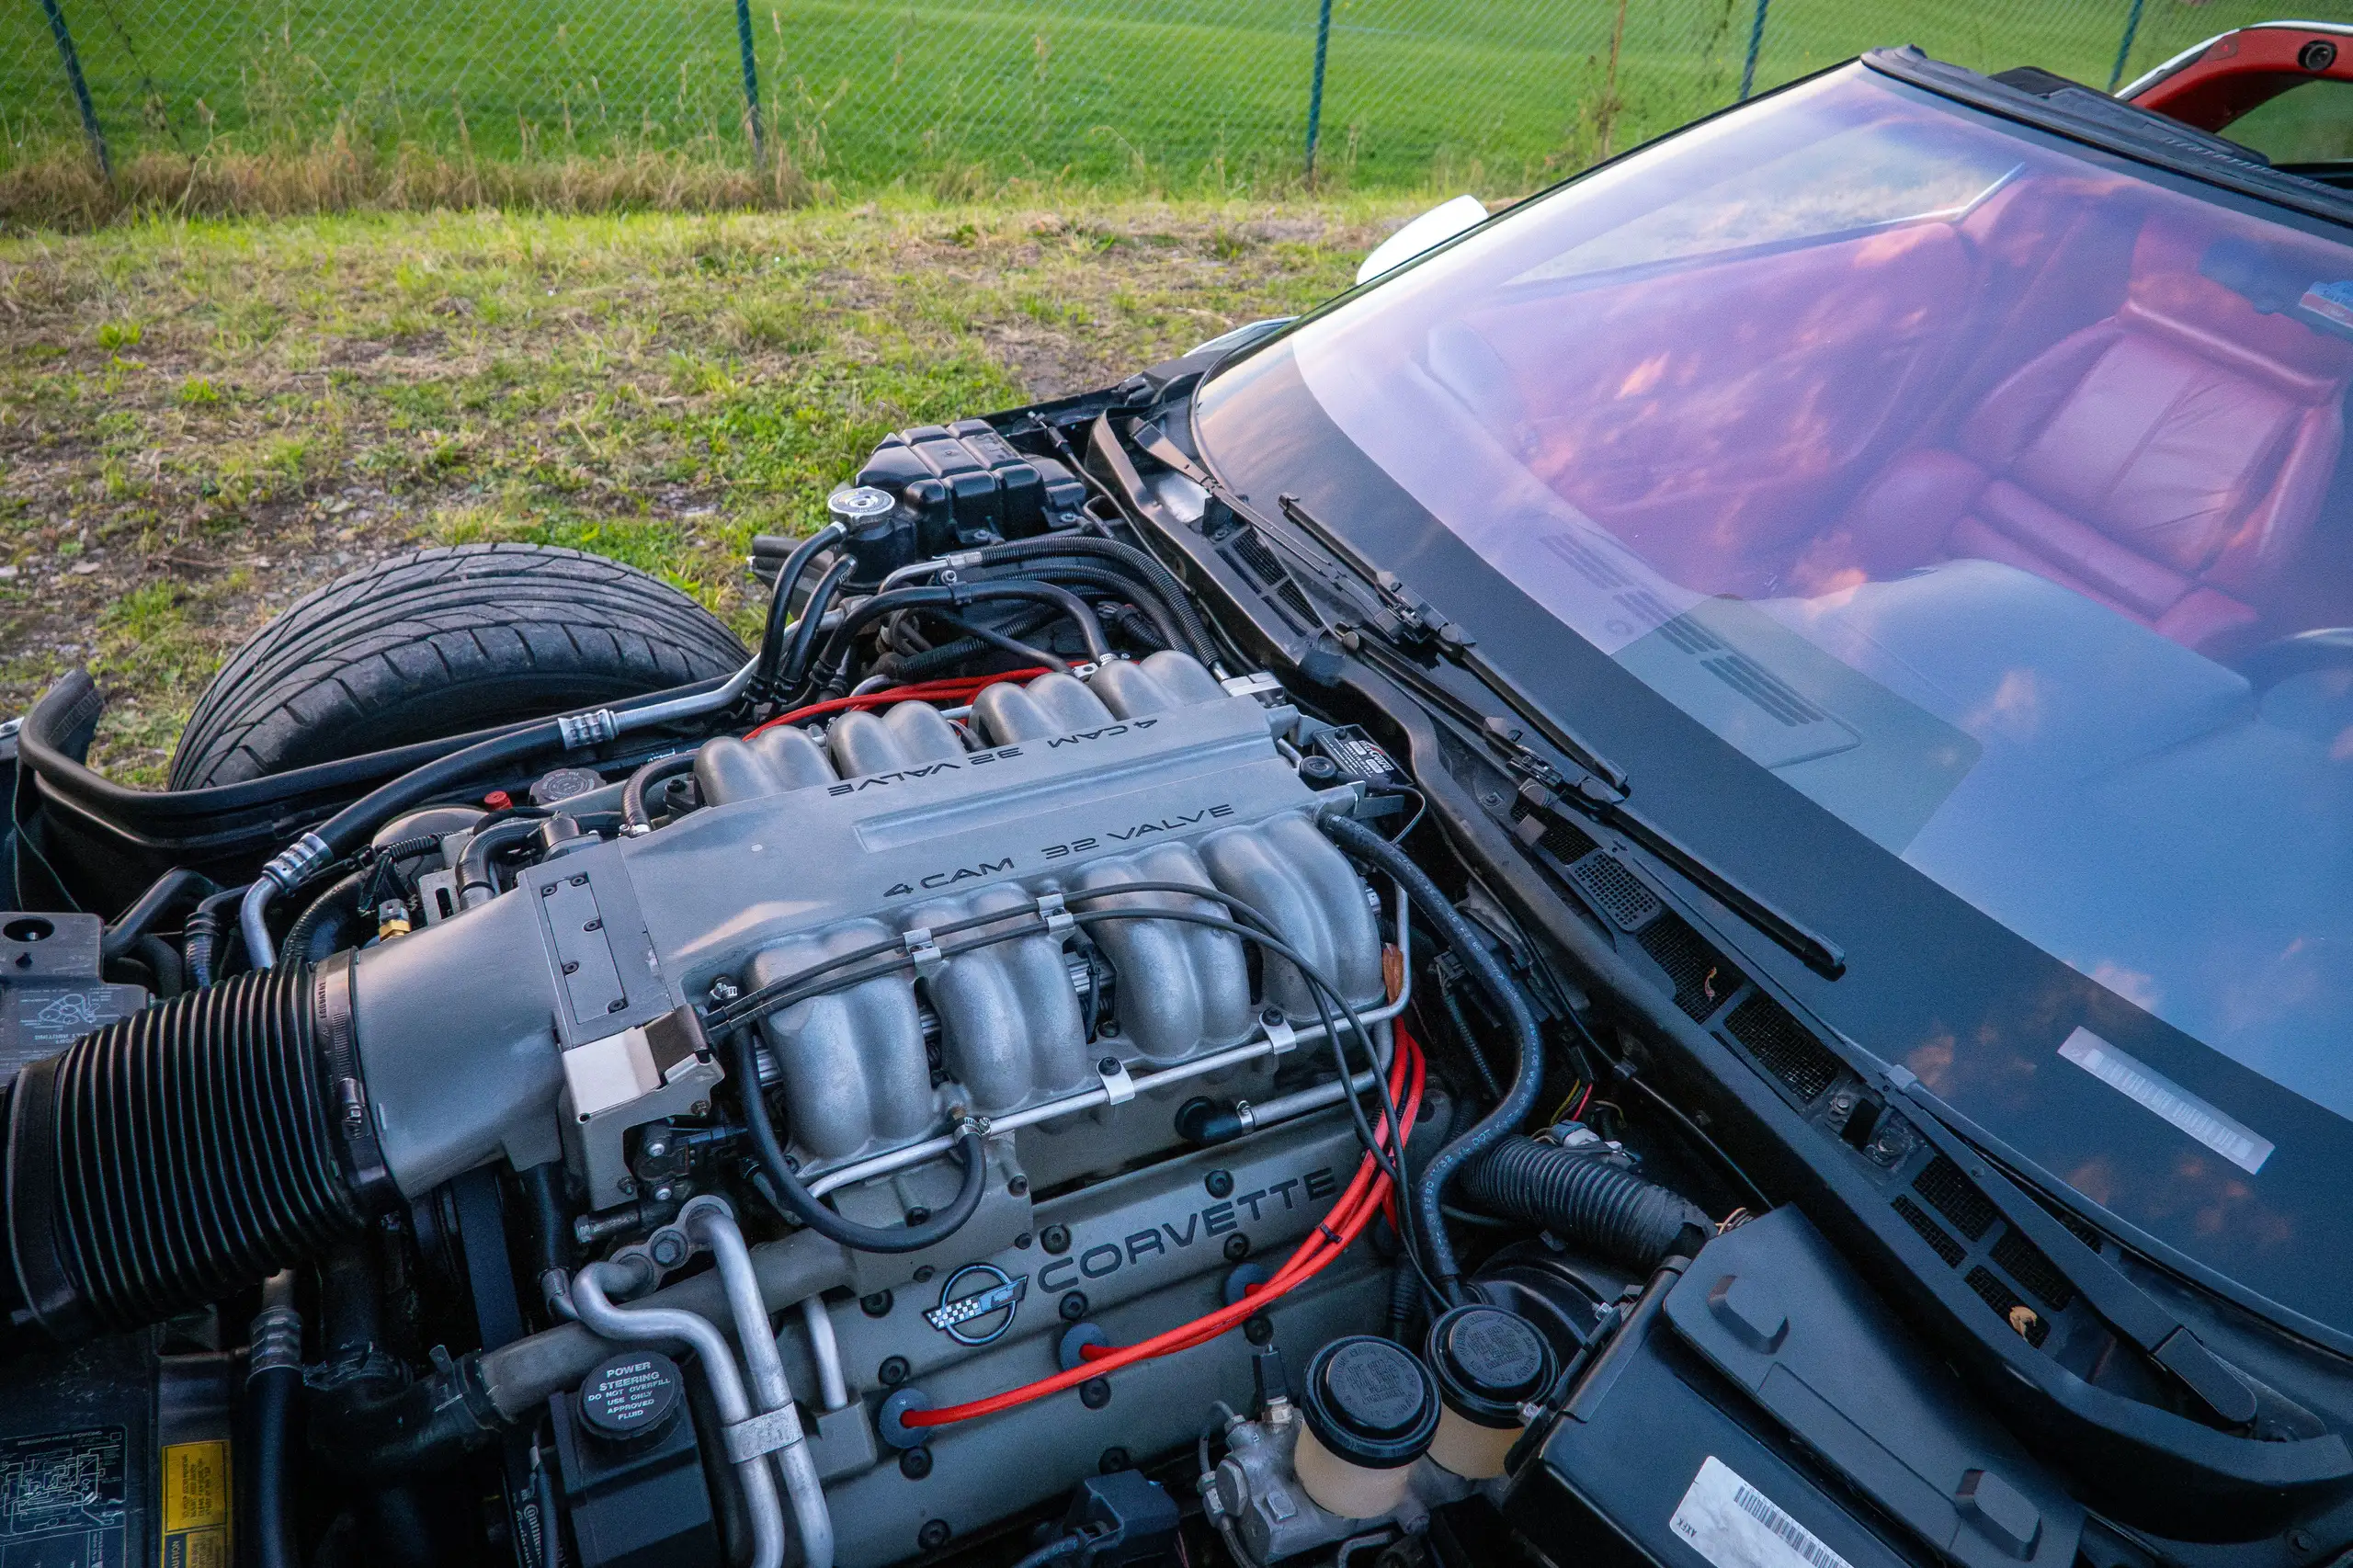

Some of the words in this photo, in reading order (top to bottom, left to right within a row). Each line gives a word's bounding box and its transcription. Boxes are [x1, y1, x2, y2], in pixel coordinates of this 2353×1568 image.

[967, 745, 1025, 765] 32
[826, 762, 961, 797] VALVE
[1040, 837, 1100, 860] 32
[1106, 802, 1235, 841] VALVE
[1037, 1167, 1337, 1294] CORVETTE
[606, 1361, 652, 1379] POWER
[587, 1392, 602, 1402] DO
[606, 1389, 625, 1399] NOT
[629, 1378, 671, 1393] OVERFILL
[598, 1371, 660, 1392] STEERING
[607, 1397, 625, 1406] USE
[631, 1391, 654, 1401] ONLY
[607, 1399, 655, 1415] APPROVED
[618, 1409, 644, 1421] FLUID
